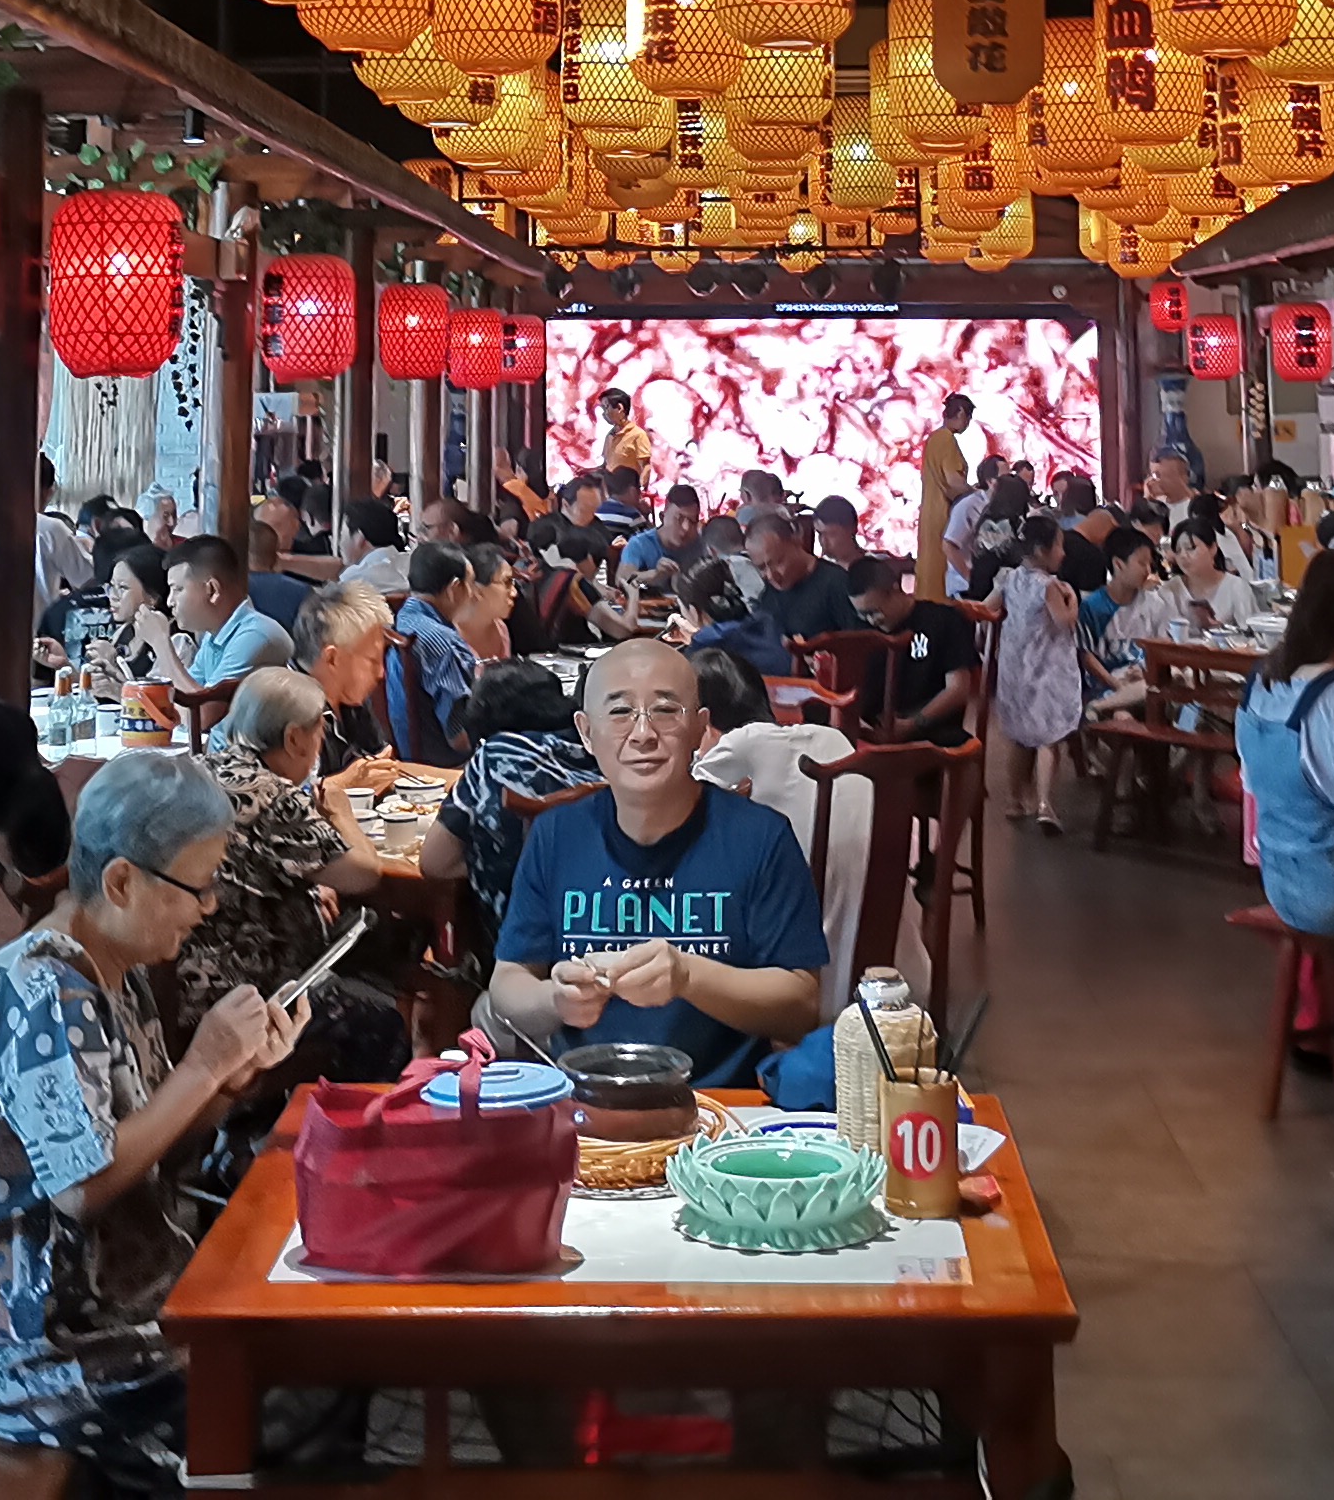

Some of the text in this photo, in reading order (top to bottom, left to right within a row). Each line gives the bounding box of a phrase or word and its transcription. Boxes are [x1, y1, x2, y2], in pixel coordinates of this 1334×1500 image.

[603, 875, 675, 890] A GREEN
[563, 890, 732, 934] PLANET
[897, 1119, 942, 1174] 10
